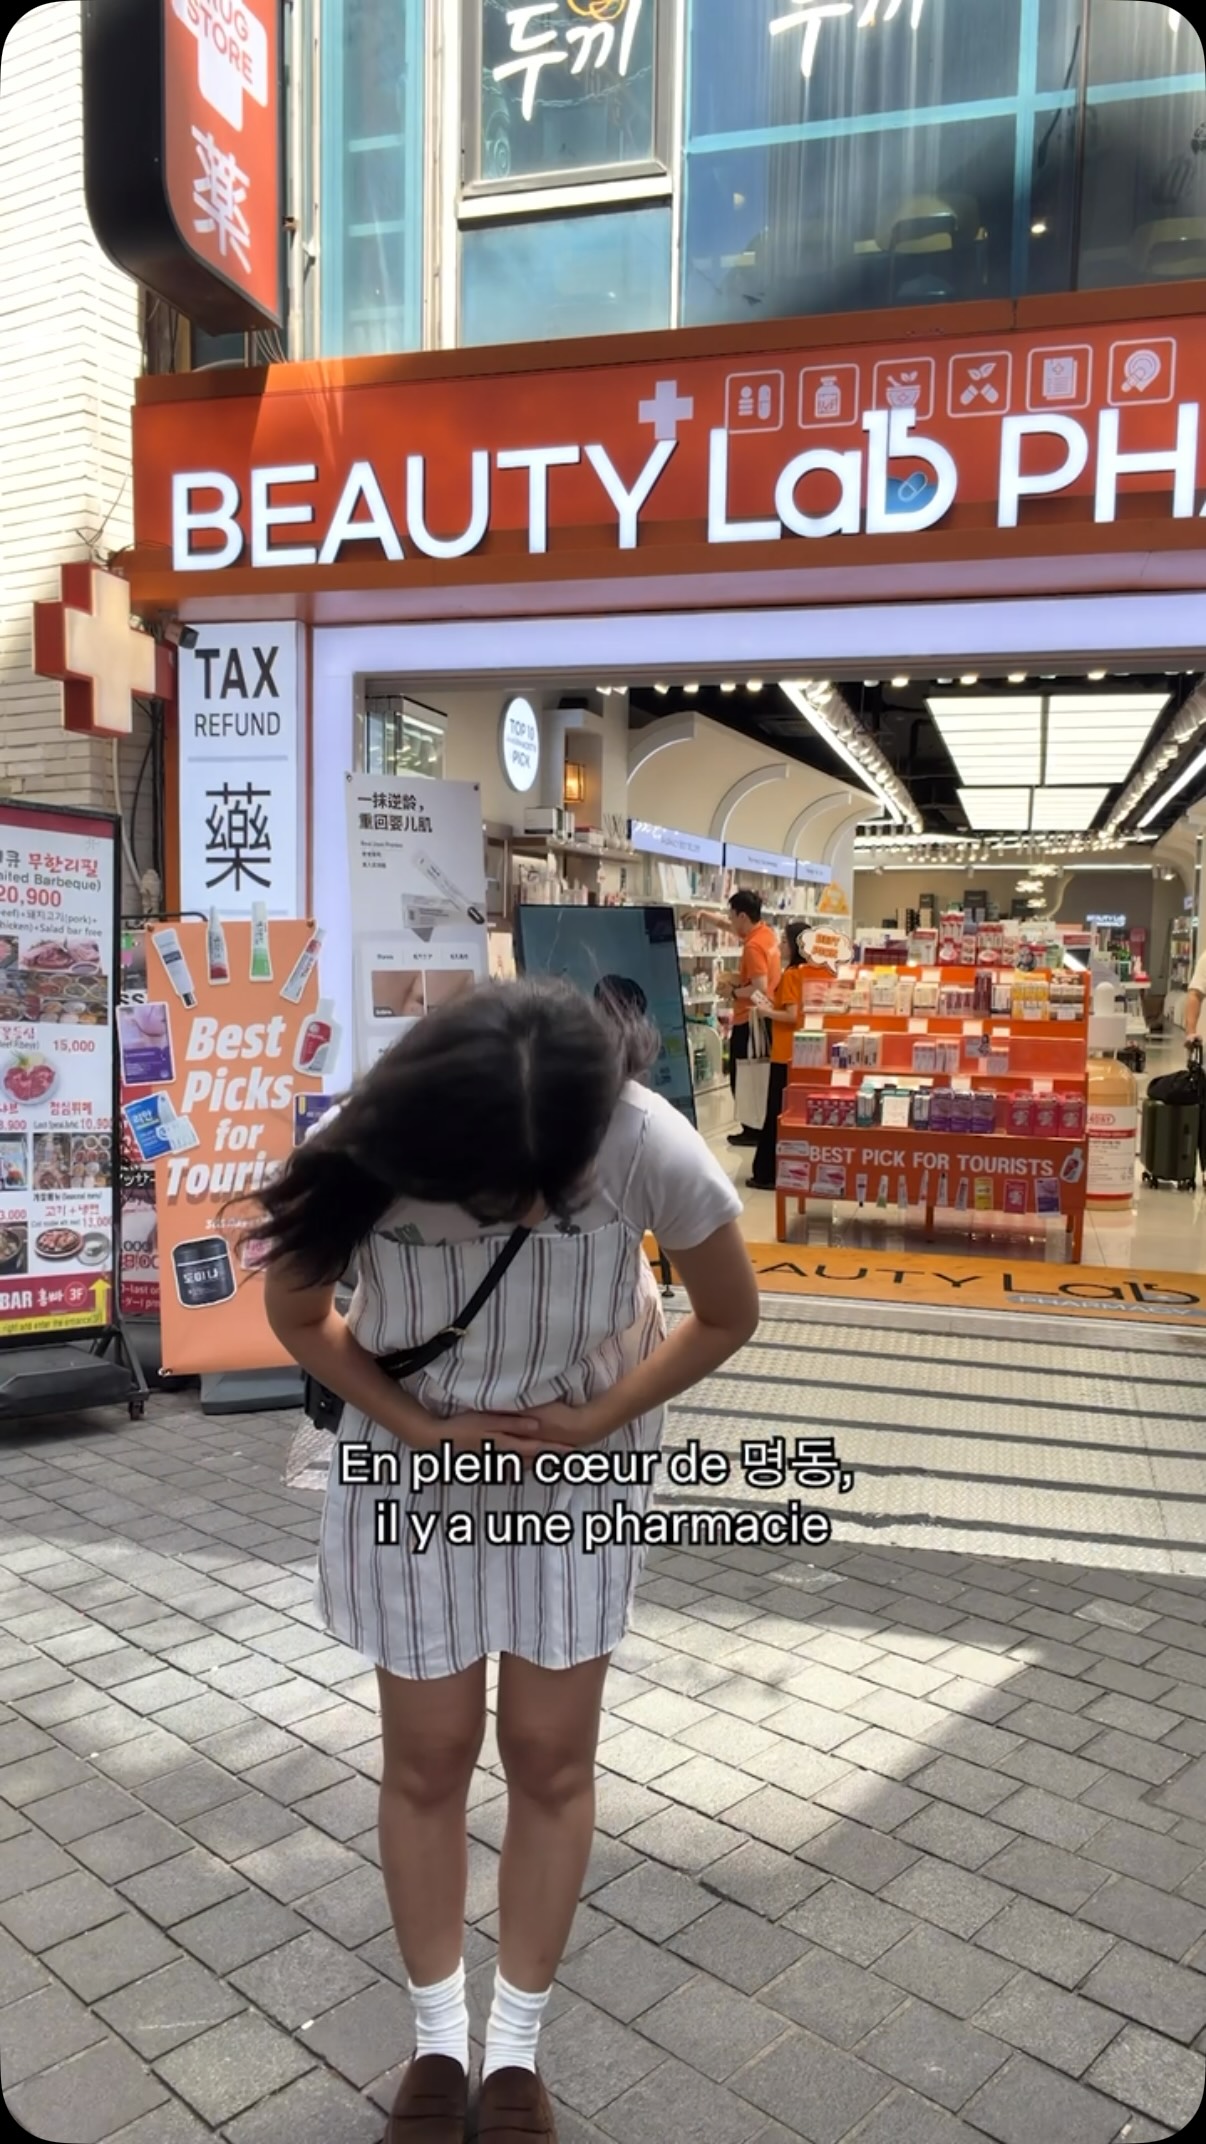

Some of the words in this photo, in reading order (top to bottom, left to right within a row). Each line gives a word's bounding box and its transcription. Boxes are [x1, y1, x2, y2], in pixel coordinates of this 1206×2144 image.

[187, 0, 253, 85] STORE
[172, 439, 679, 571] BEAUTY
[707, 408, 958, 543] Lab
[998, 402, 1206, 528] PH
[195, 646, 280, 700] TAX
[194, 712, 281, 737] REFUND
[205, 782, 271, 891] 藥
[28, 853, 98, 878] 무한리필
[34, 874, 101, 892] Barbeque)
[53, 1040, 95, 1052] 15,000
[185, 1016, 286, 1061] Best
[181, 1066, 294, 1113] Picks
[214, 1118, 265, 1151] for
[808, 1145, 855, 1164] BEST
[862, 1149, 906, 1168] PICK
[913, 1151, 949, 1170] FOR
[957, 1154, 1054, 1177] TOURISTS
[752, 1259, 982, 1288] AUTY
[1003, 1273, 1201, 1305] Lab
[0, 1291, 32, 1310] BAR
[69, 1288, 84, 1301] 3F
[1018, 1295, 1192, 1316] PHARMACY
